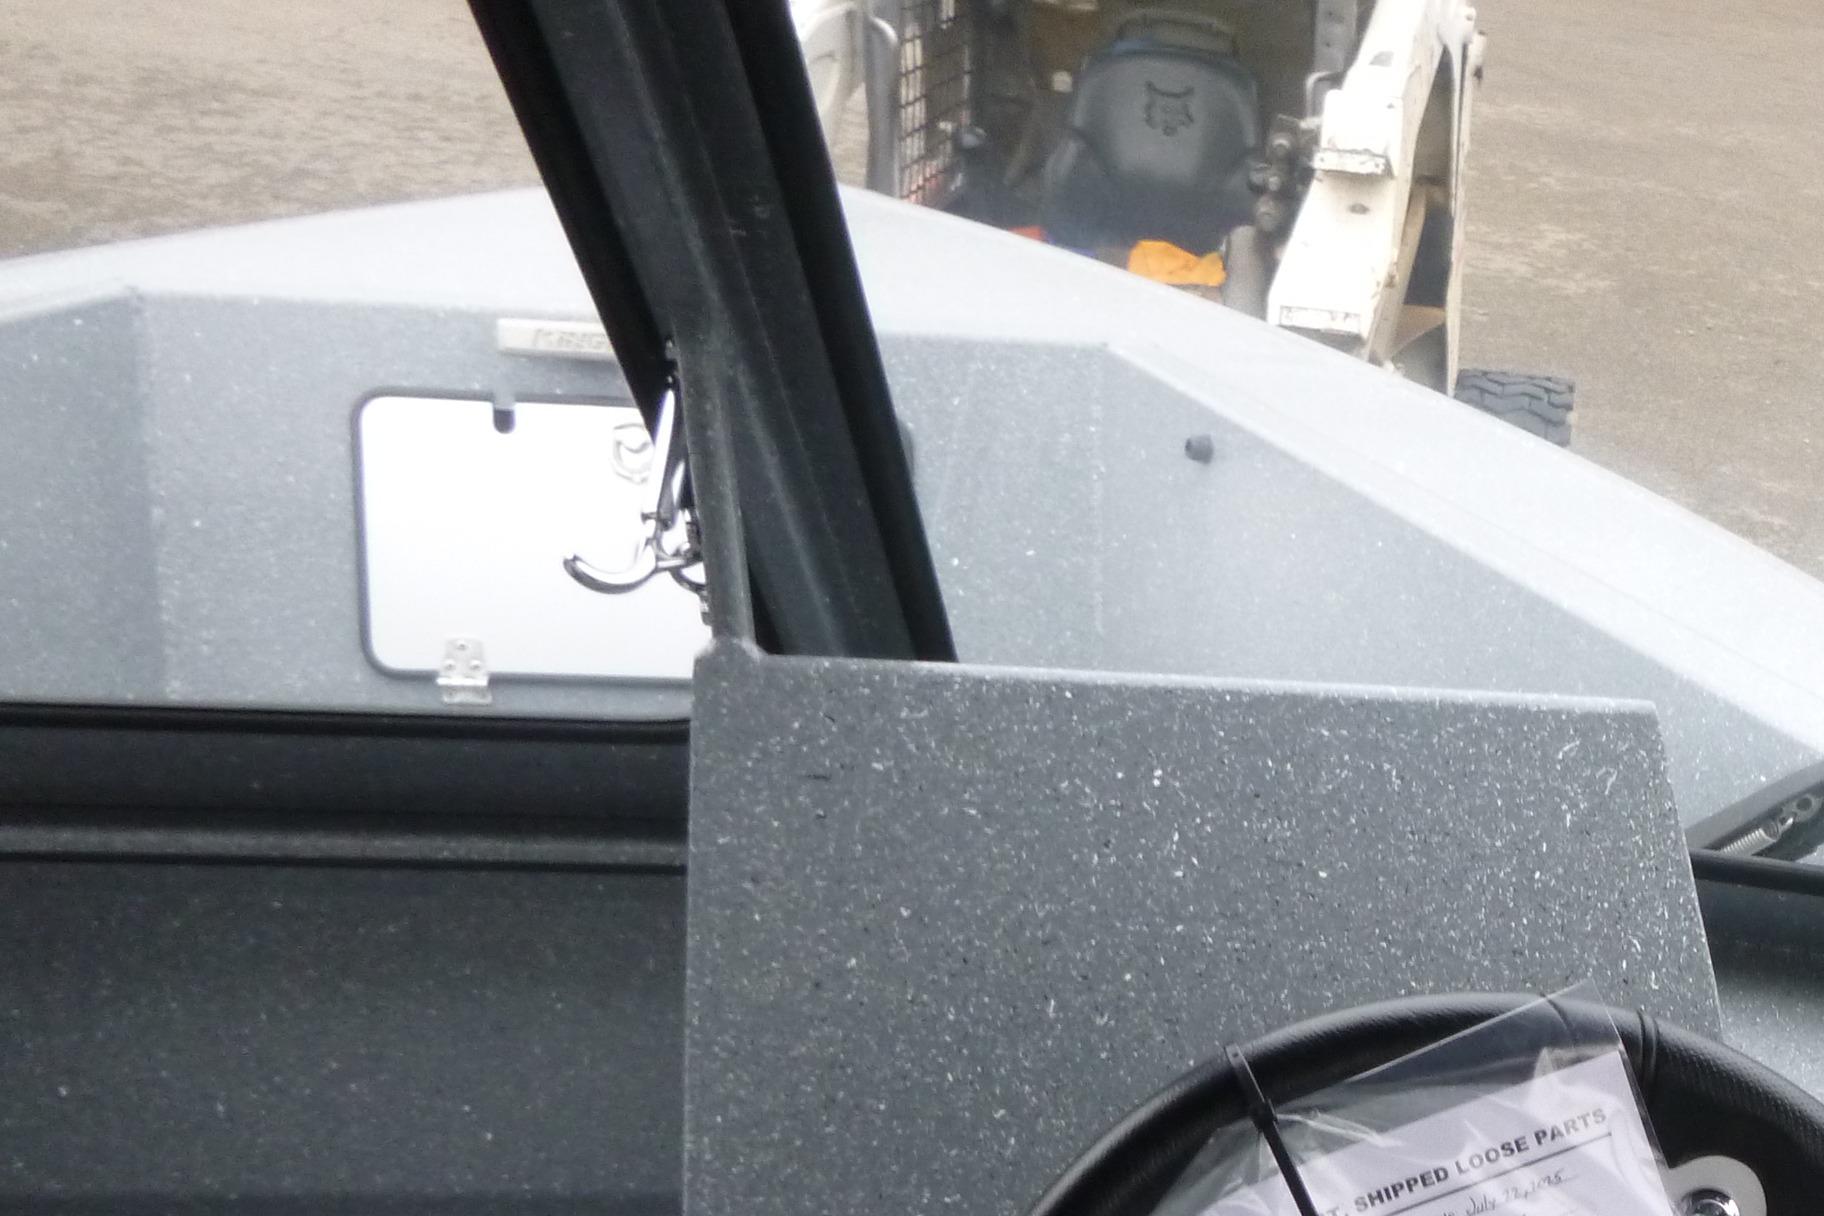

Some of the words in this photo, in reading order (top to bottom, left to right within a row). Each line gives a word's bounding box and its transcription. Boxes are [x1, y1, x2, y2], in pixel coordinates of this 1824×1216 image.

[1353, 1163, 1450, 1213] SHIPPED
[1454, 1134, 1529, 1176] LOOSE
[1533, 1105, 1607, 1147] PARTS
